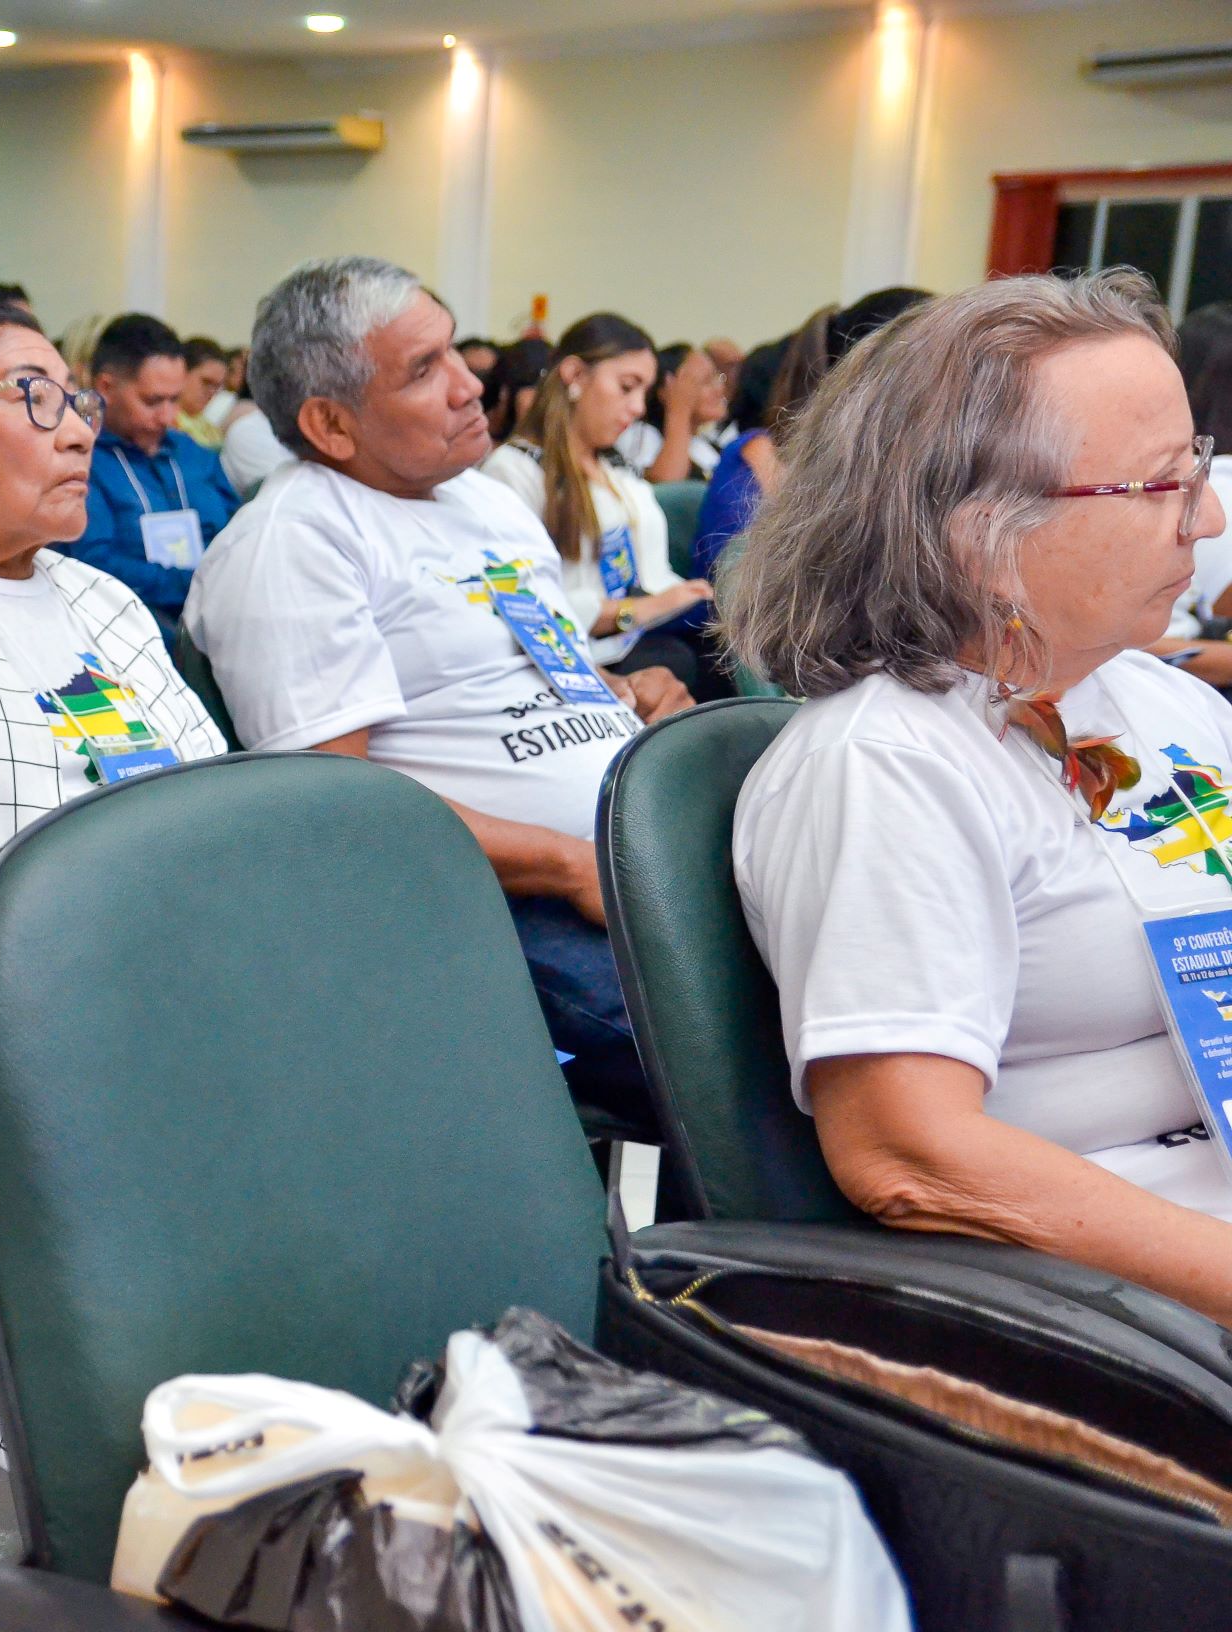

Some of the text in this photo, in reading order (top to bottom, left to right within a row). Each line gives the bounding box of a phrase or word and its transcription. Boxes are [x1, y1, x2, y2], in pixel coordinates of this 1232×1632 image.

[501, 712, 625, 763] ESTADUAL
[1173, 937, 1187, 952] 9ª
[1171, 952, 1222, 972] ESTADUAL
